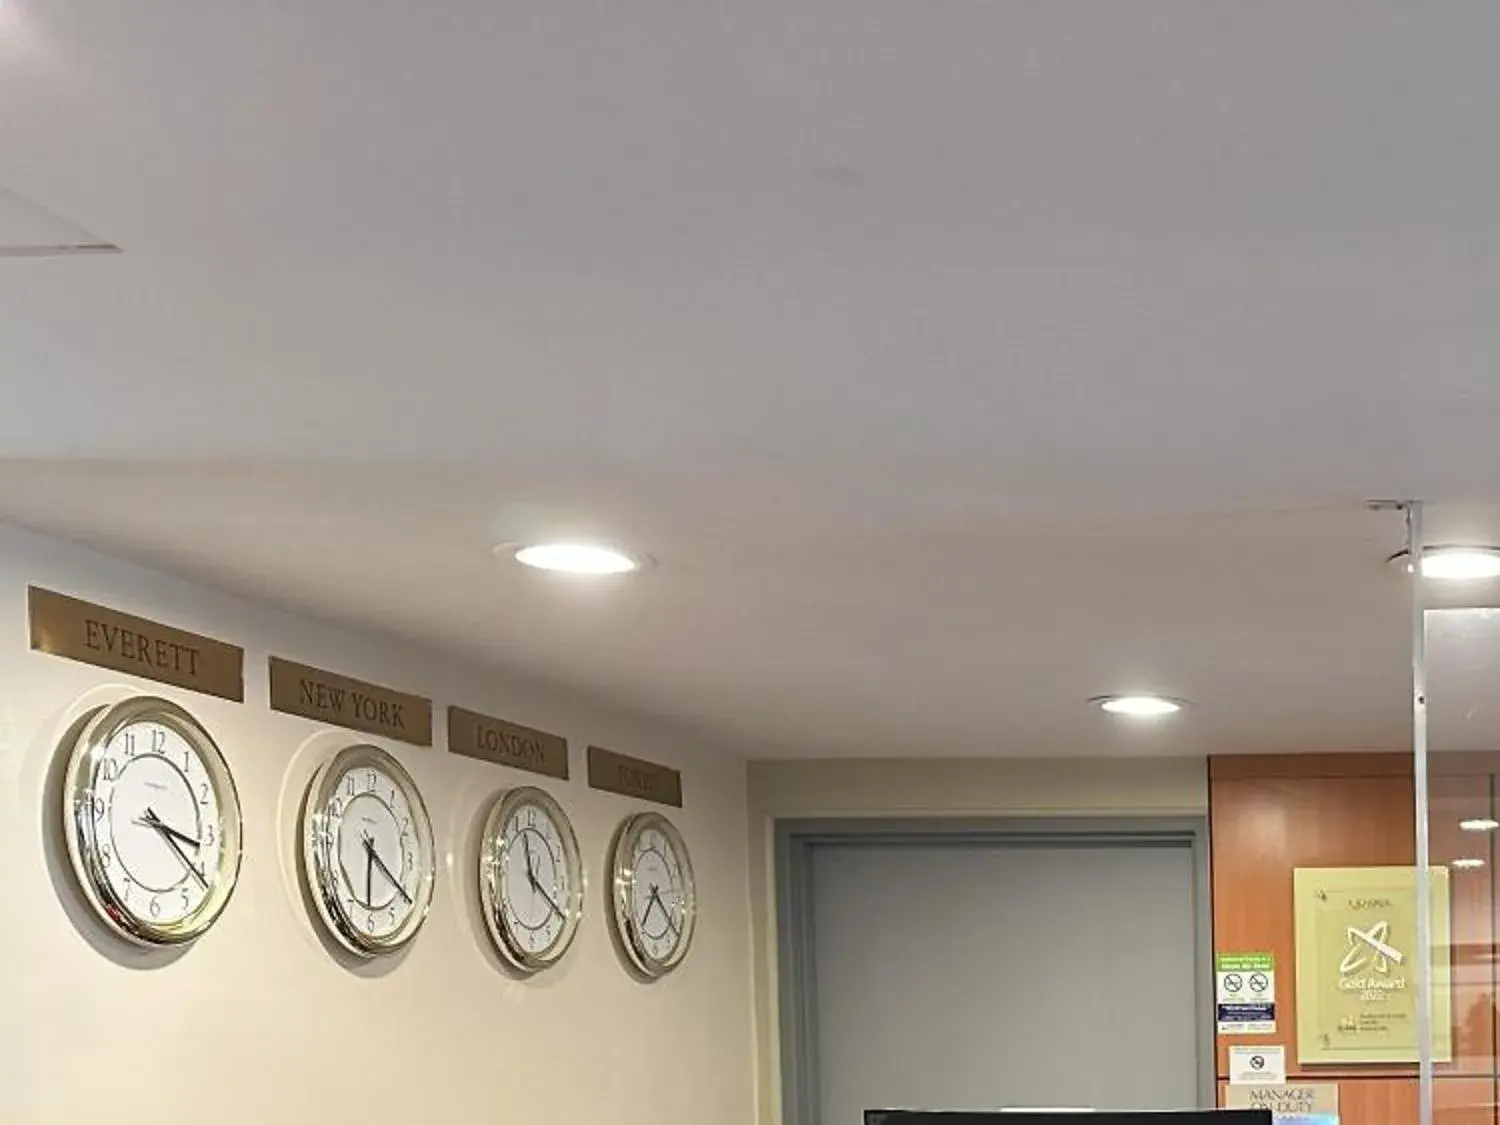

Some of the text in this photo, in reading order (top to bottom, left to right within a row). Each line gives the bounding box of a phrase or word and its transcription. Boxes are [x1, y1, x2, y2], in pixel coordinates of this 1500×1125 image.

[84, 620, 201, 676] EVERETT
[300, 678, 406, 729] NEW YORK
[477, 725, 544, 763] LONDON
[1250, 1088, 1316, 1101] MANAGER
